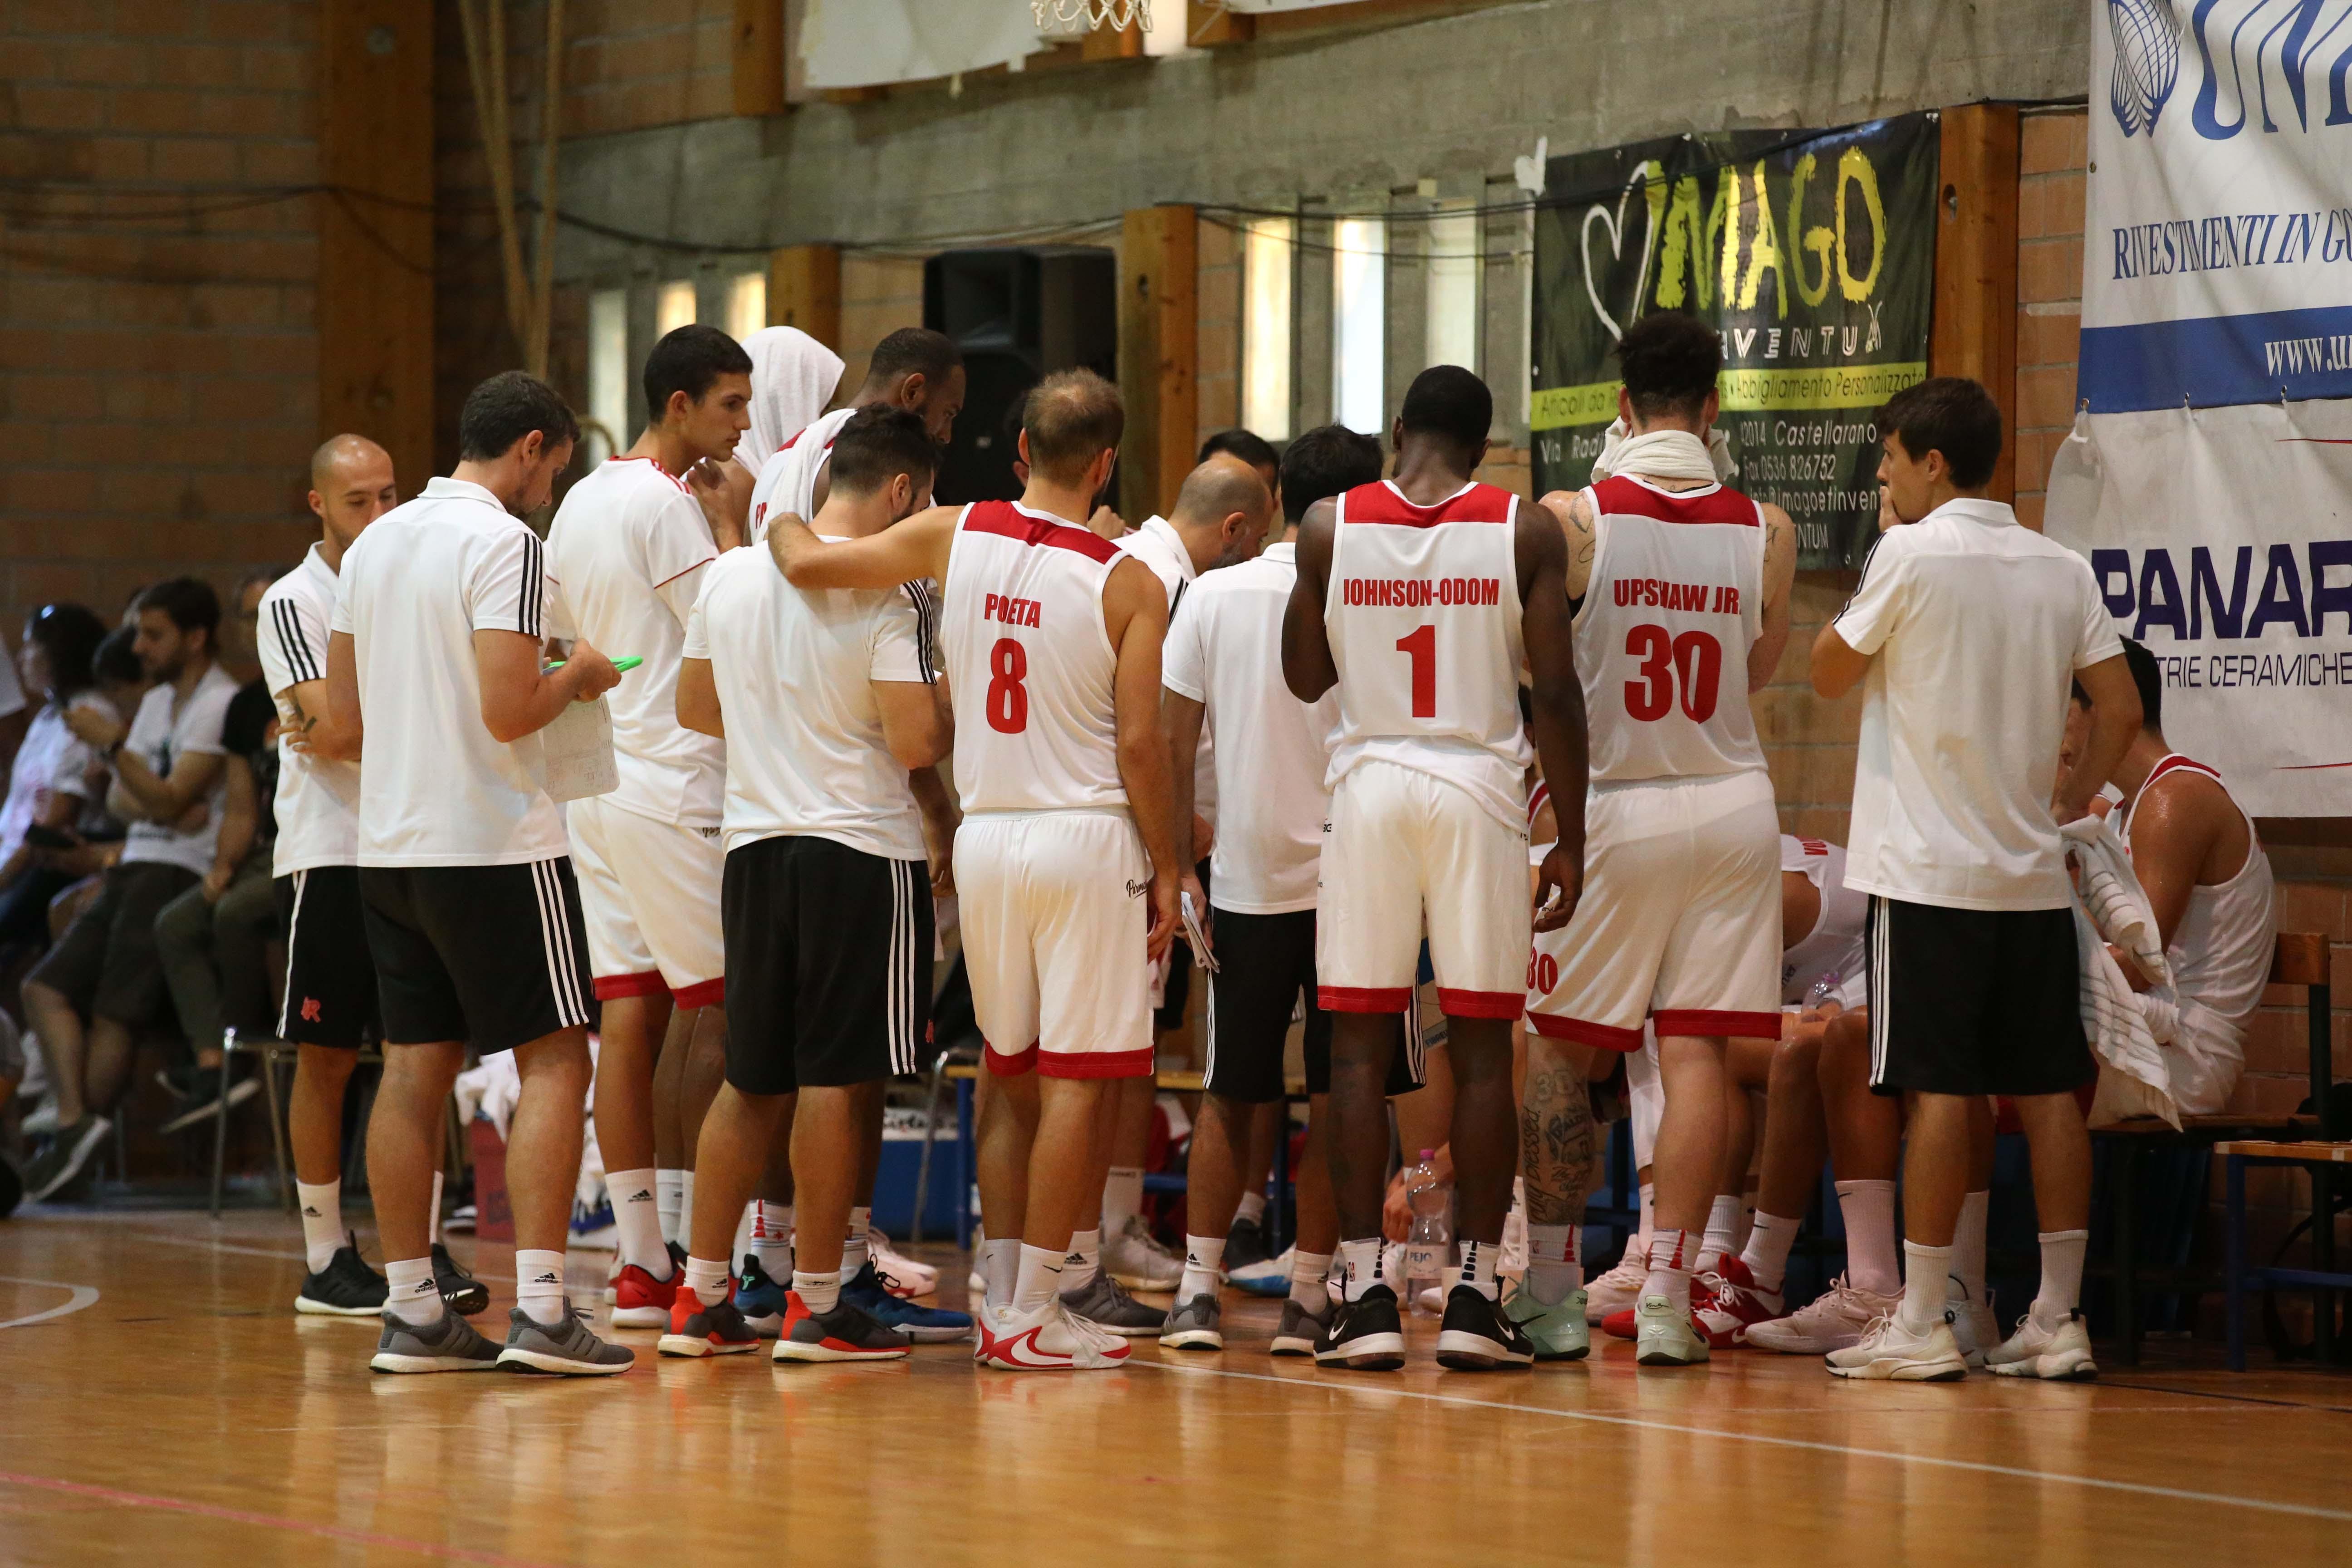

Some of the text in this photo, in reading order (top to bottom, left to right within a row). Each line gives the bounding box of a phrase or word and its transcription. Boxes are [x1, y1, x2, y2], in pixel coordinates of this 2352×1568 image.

[2113, 215, 2279, 279] RIVESTIMENTI
[2274, 212, 2321, 263] IN
[1737, 373, 1832, 405] Abbigliamento
[1775, 420, 1877, 446] Castellarano
[1540, 438, 1561, 465] Via
[1760, 455, 1786, 481] 0536
[1790, 454, 1836, 481] 826752
[1794, 523, 1829, 549] NTUM
[1343, 578, 1499, 607] JOHNSON-ODOM
[1614, 578, 1709, 612] UPSHAW
[984, 593, 1042, 629] POETA
[986, 638, 1028, 734] 8
[1396, 625, 1436, 718] 1
[1624, 624, 1722, 725] 30
[2210, 652, 2352, 687] CERAMICHE
